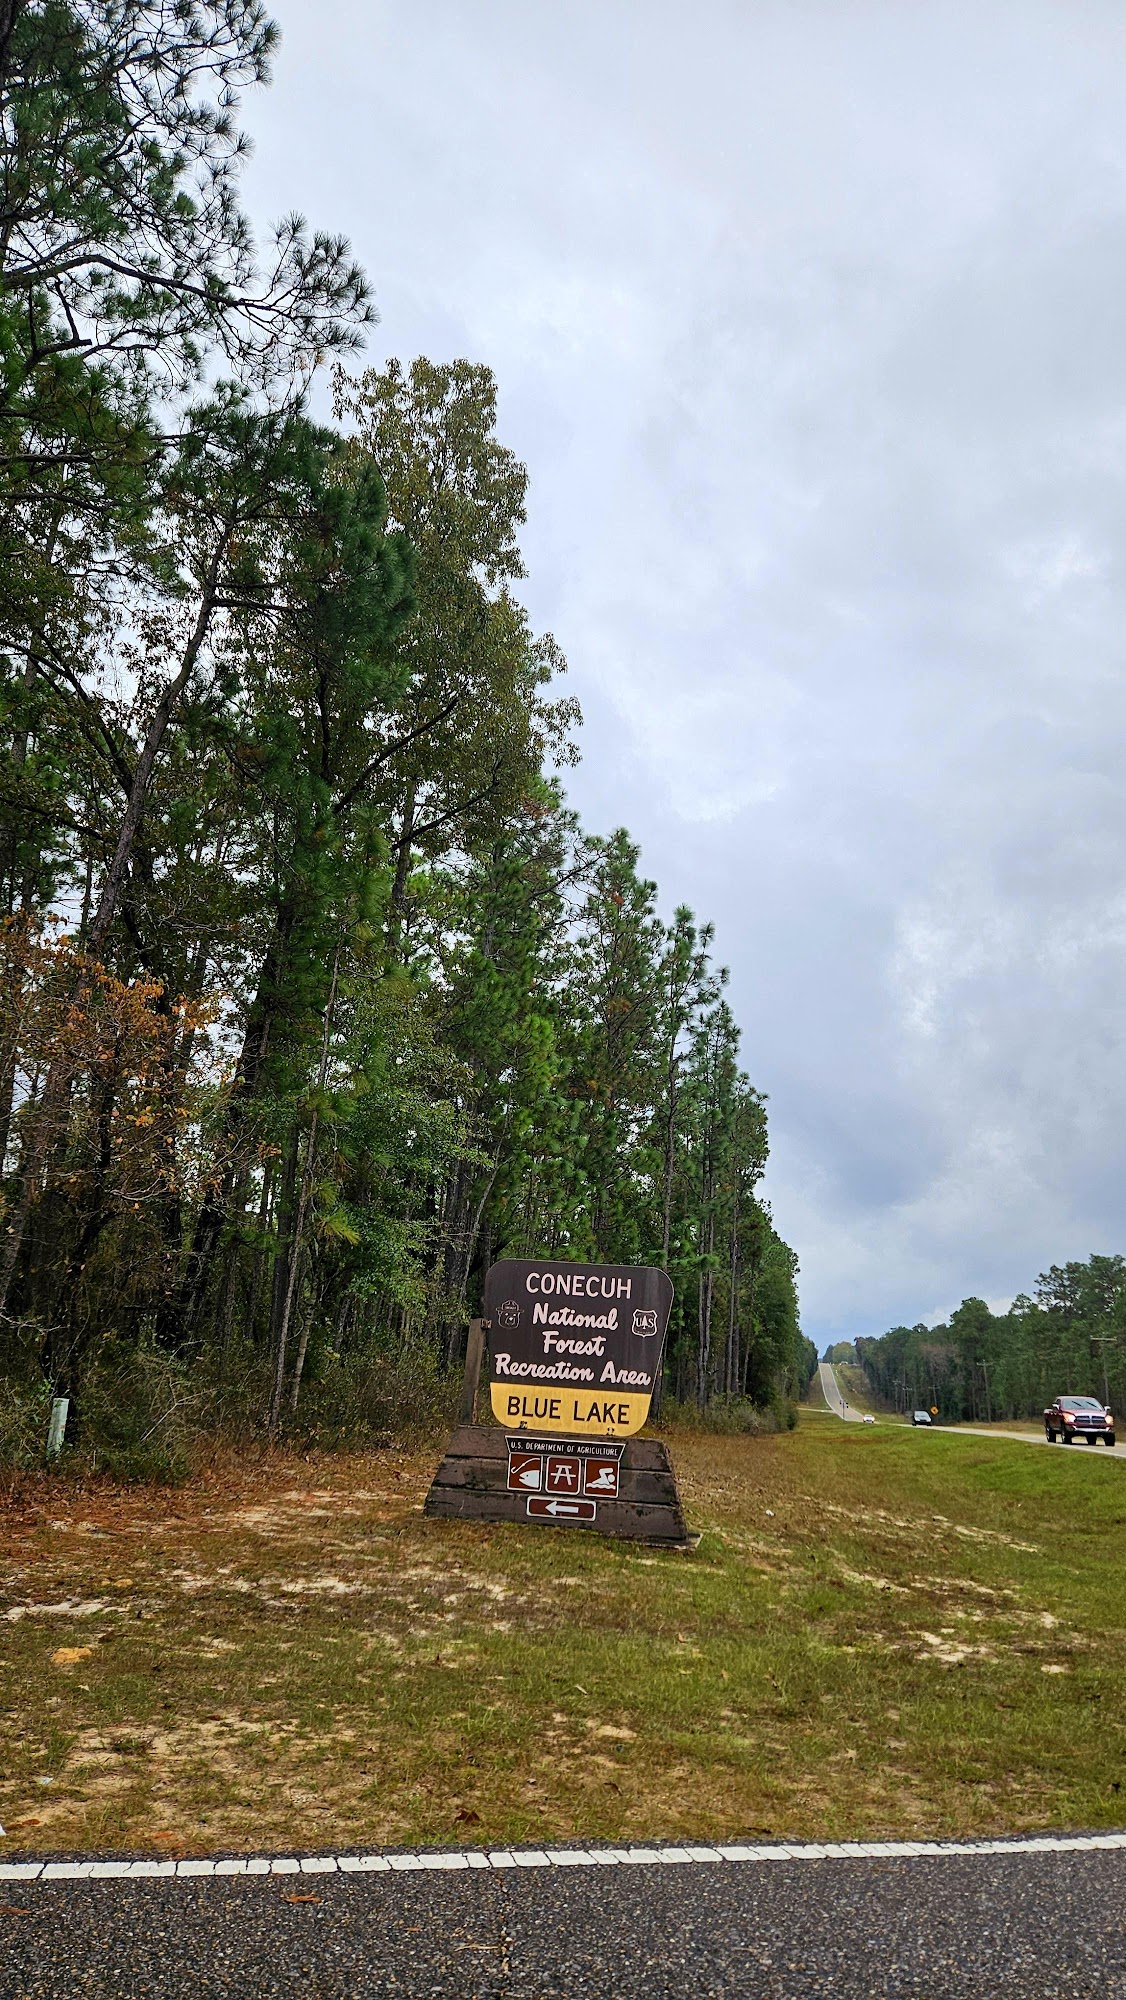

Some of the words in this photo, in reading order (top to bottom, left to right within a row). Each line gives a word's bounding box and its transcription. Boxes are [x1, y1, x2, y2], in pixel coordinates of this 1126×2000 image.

[526, 1272, 632, 1299] CONECUH
[532, 1302, 618, 1331] National
[542, 1331, 606, 1356] Forest
[494, 1353, 594, 1381] Recreation
[600, 1360, 651, 1385] Area
[507, 1396, 561, 1419] BLUE
[573, 1400, 630, 1424] LAKE
[510, 1441, 523, 1449] U.S.
[525, 1442, 564, 1452] DEPARTMENT
[566, 1445, 575, 1453] OF
[576, 1446, 618, 1456] AGRICULTURE
